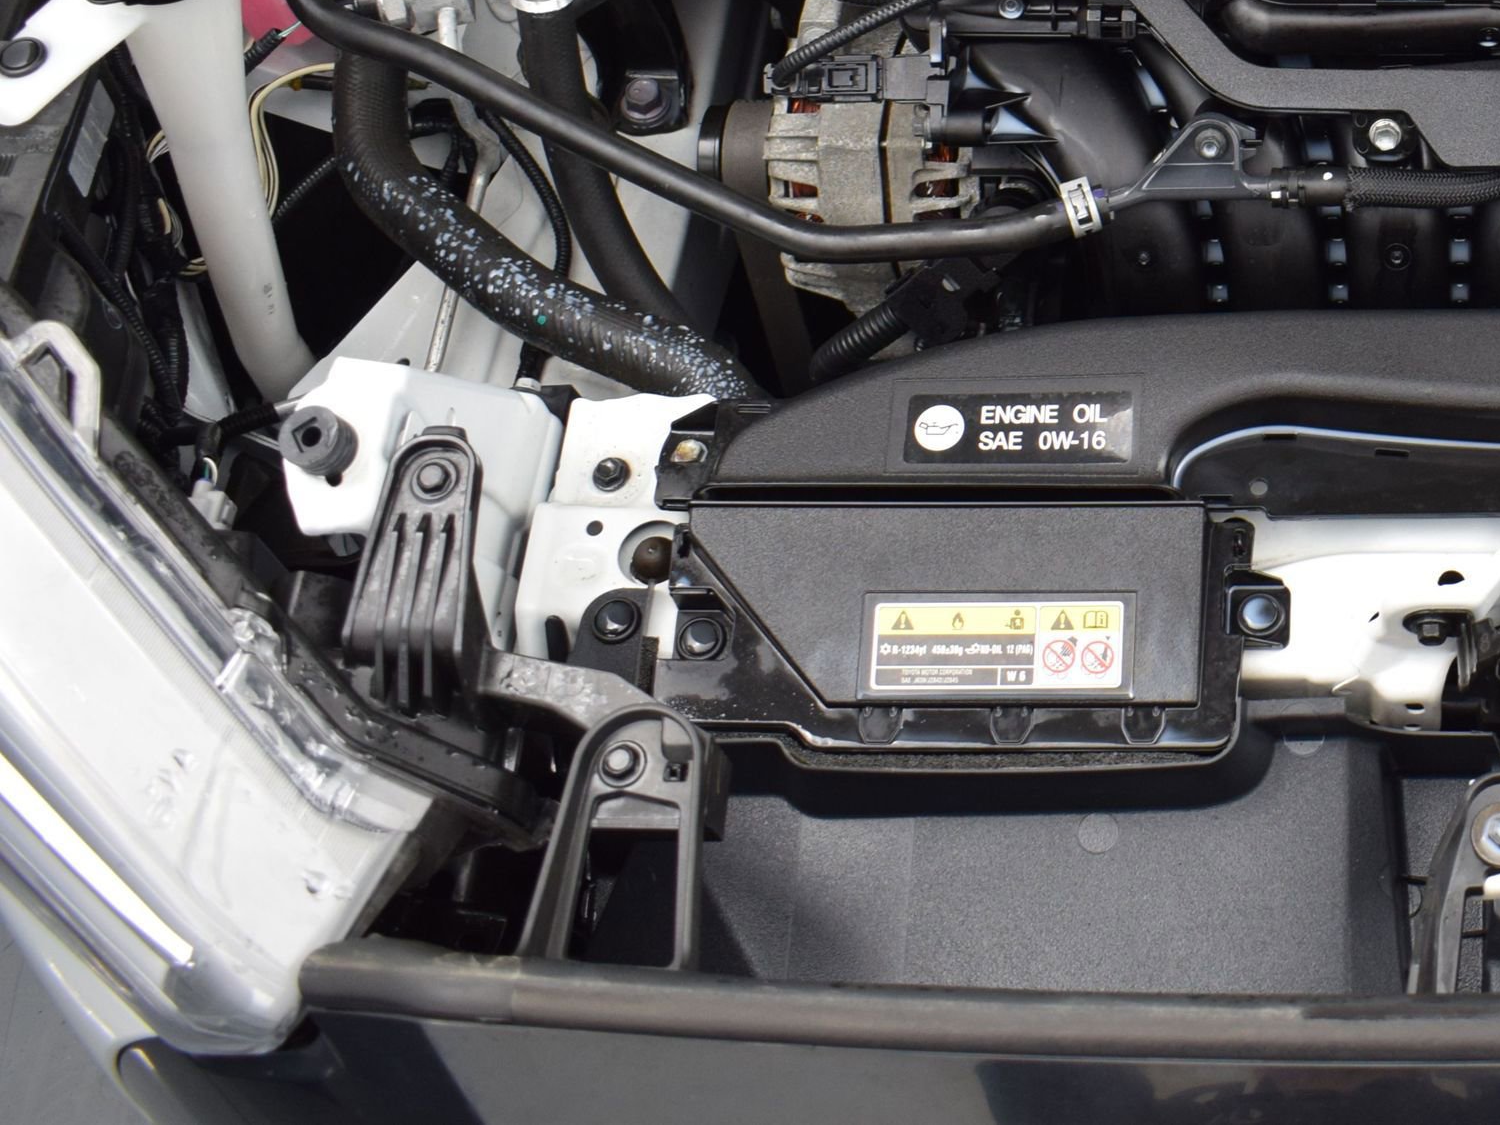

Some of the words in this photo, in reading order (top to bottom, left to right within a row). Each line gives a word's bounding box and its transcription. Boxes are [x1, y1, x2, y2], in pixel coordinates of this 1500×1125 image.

[980, 405, 1060, 424] ENGINE
[1072, 403, 1108, 424] OIL
[978, 431, 1024, 451] SAE
[1038, 430, 1106, 451] 0W-16
[1006, 670, 1017, 682] W
